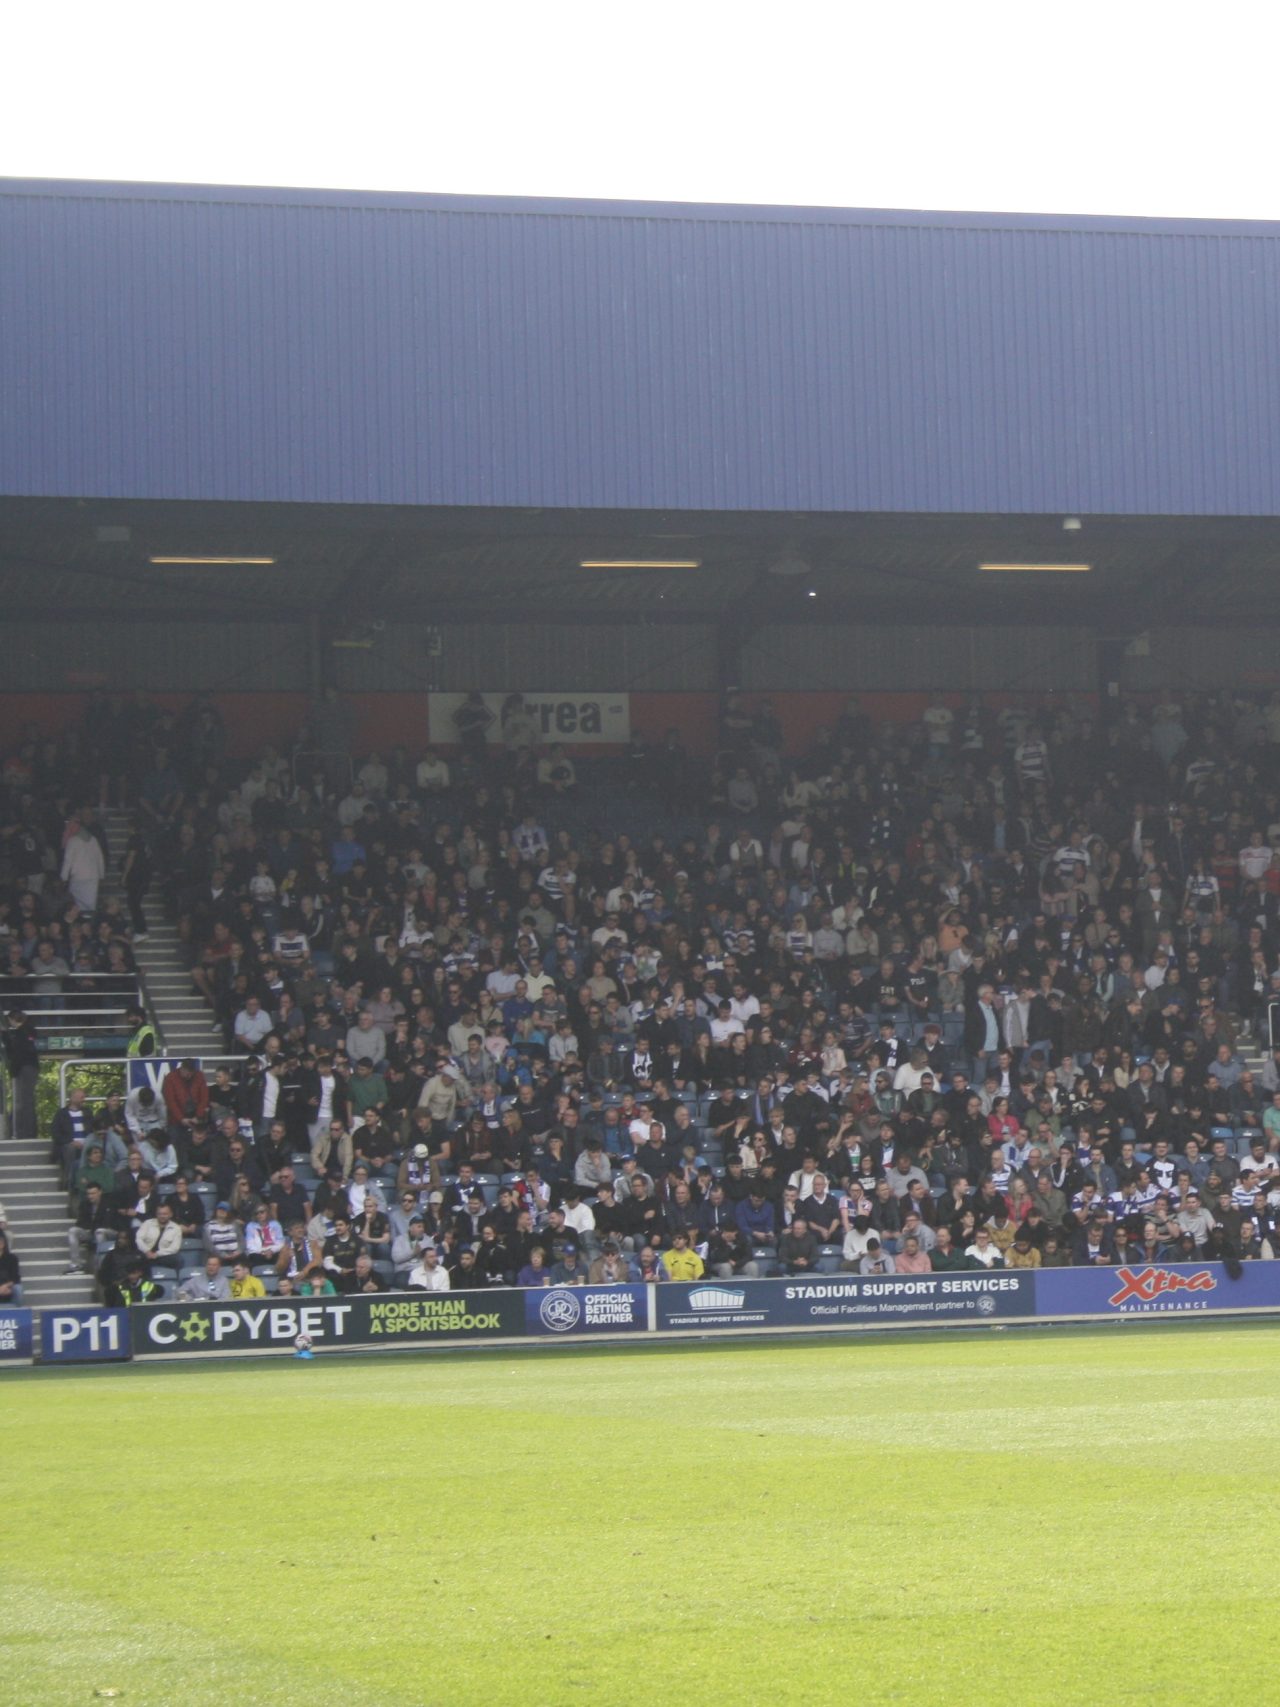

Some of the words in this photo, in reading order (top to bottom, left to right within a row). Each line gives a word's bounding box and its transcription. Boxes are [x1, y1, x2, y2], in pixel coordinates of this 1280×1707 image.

[785, 1285, 857, 1299] STADIUM
[862, 1282, 937, 1296] SUPPORT
[942, 1279, 1019, 1293] SERVICES
[1108, 1266, 1218, 1306] Xtra
[585, 1293, 634, 1305] OFFICIAL
[1120, 1301, 1208, 1312] MAINTENANCE
[370, 1303, 420, 1319] MORE
[423, 1300, 465, 1316] THAN
[585, 1303, 631, 1315] BETTING
[810, 1305, 839, 1315] Official
[841, 1304, 877, 1314] Facilities
[879, 1302, 933, 1313] Management
[935, 1301, 965, 1311] partner
[370, 1319, 383, 1334] A
[386, 1313, 501, 1333] SPORTSBOOK
[586, 1313, 633, 1325] PARTNER
[52, 1315, 118, 1353] P11
